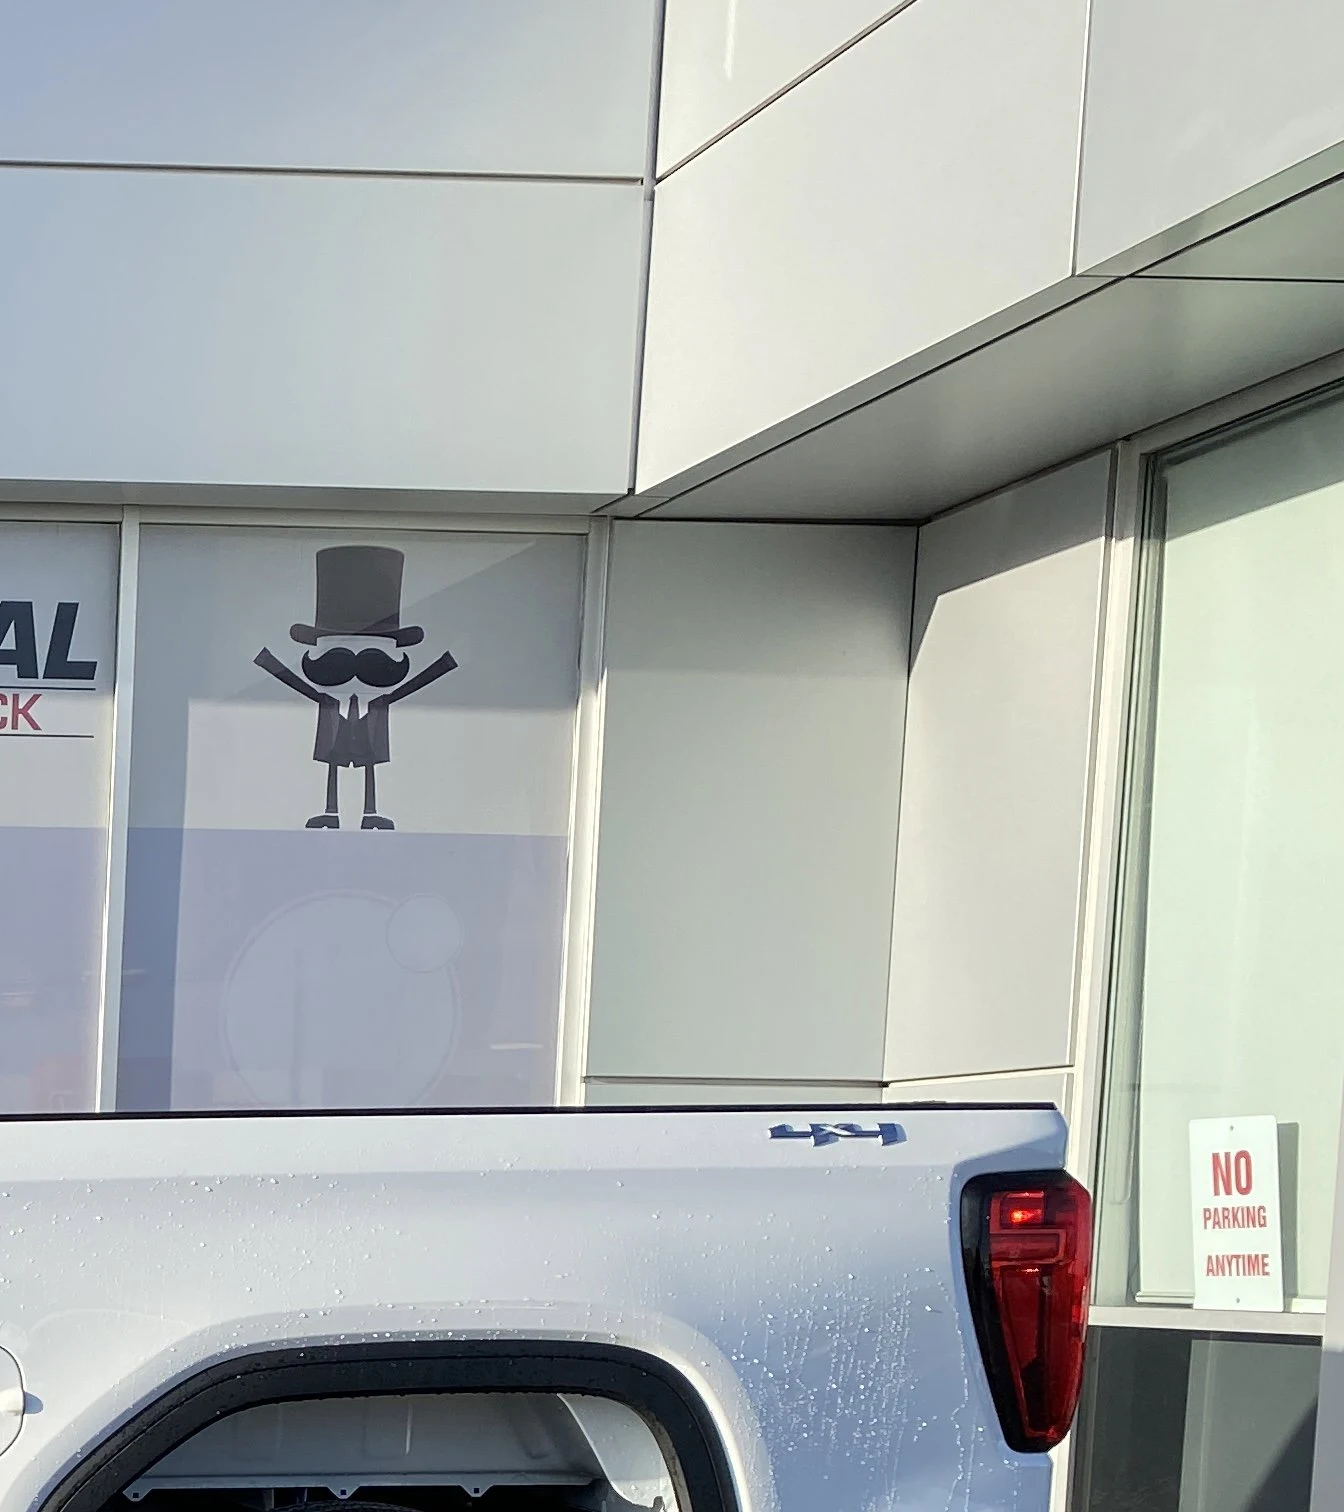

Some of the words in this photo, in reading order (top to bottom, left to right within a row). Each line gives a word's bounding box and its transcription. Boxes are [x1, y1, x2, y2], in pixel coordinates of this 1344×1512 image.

[1212, 1150, 1253, 1196] NO
[1203, 1205, 1267, 1230] PARKING
[1205, 1253, 1270, 1277] ANYTIME
